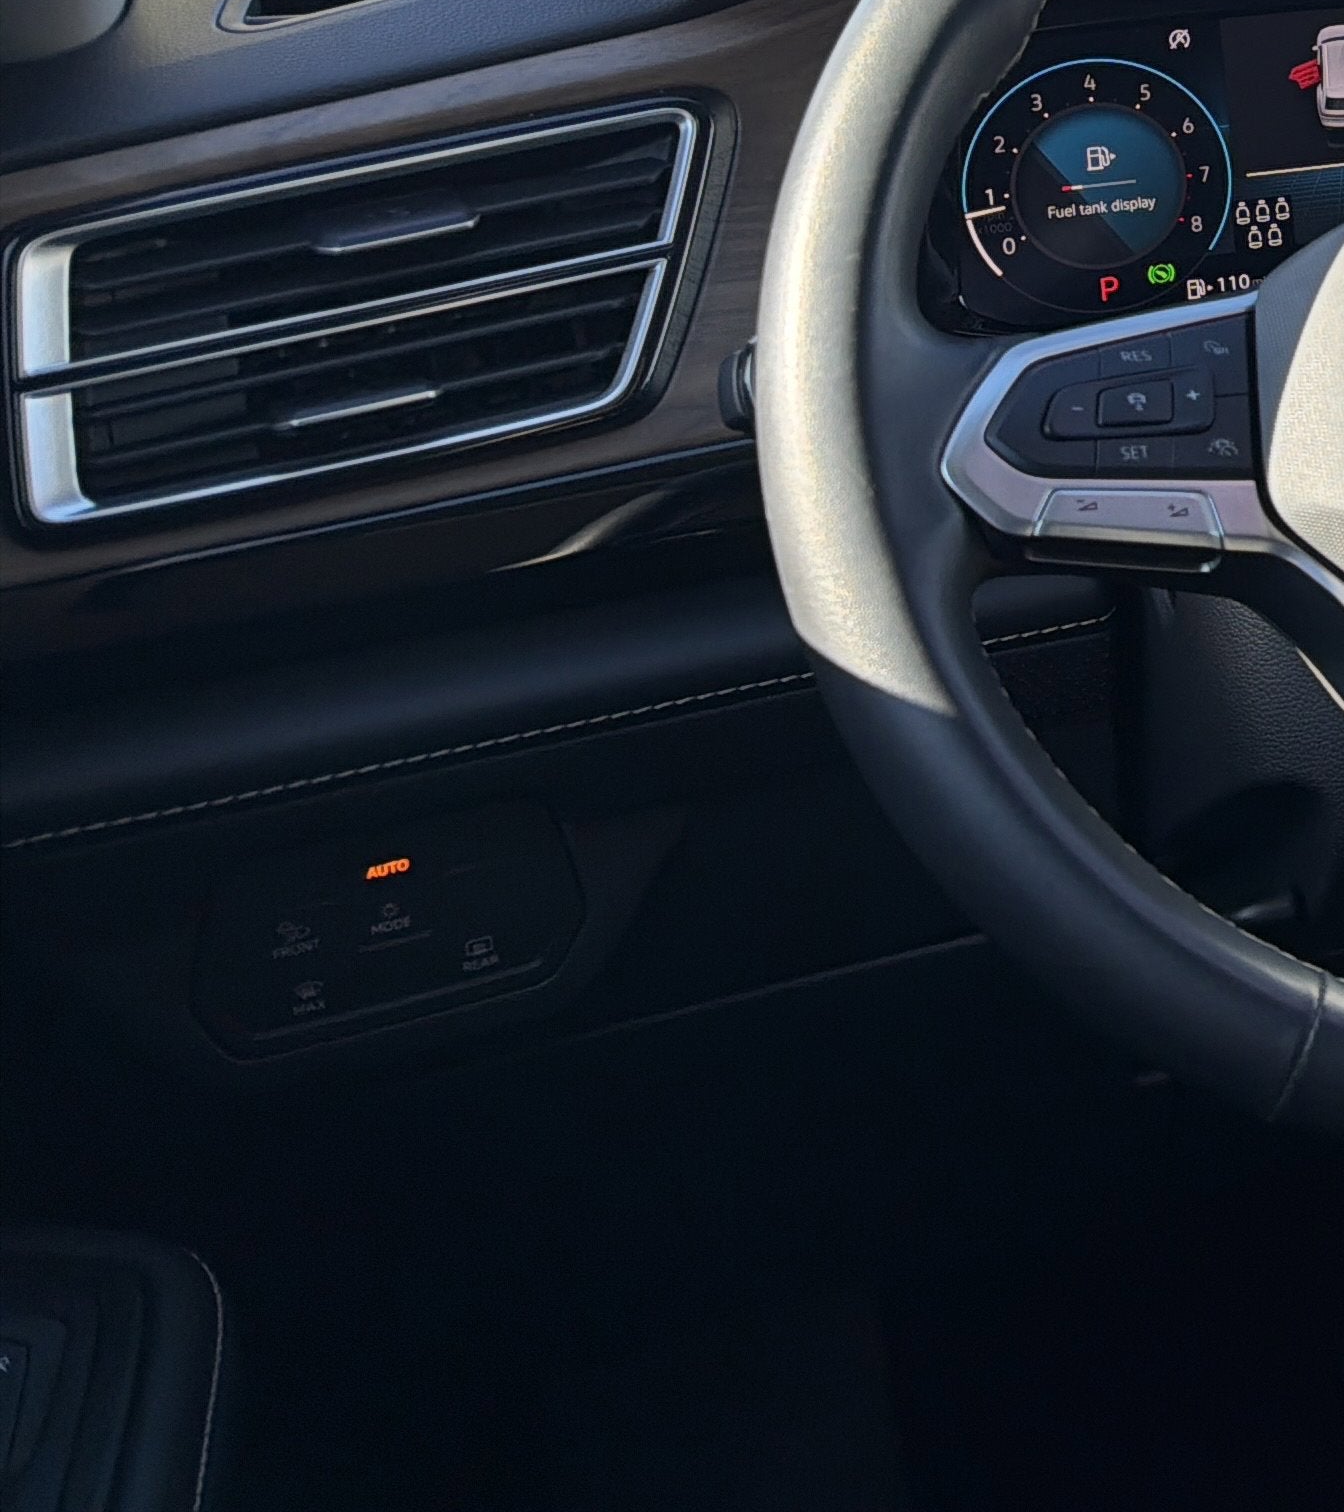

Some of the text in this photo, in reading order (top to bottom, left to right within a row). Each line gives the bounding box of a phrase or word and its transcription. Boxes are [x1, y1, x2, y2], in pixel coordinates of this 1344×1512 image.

[1084, 74, 1096, 90] 4
[1140, 84, 1151, 101] 5
[1031, 94, 1043, 112] 3
[1183, 118, 1194, 133] 6
[994, 136, 1006, 153] 2
[1198, 166, 1211, 182] 7
[985, 189, 995, 206] 1
[1047, 196, 1156, 220] Fuel tank display
[1191, 216, 1203, 232] 8
[1003, 237, 1016, 255] 0
[1099, 276, 1119, 302] P
[1217, 274, 1250, 292] 110
[1121, 350, 1153, 363] RES
[1120, 445, 1149, 460] SET
[365, 858, 411, 881] AUTO
[371, 915, 412, 935] MODE
